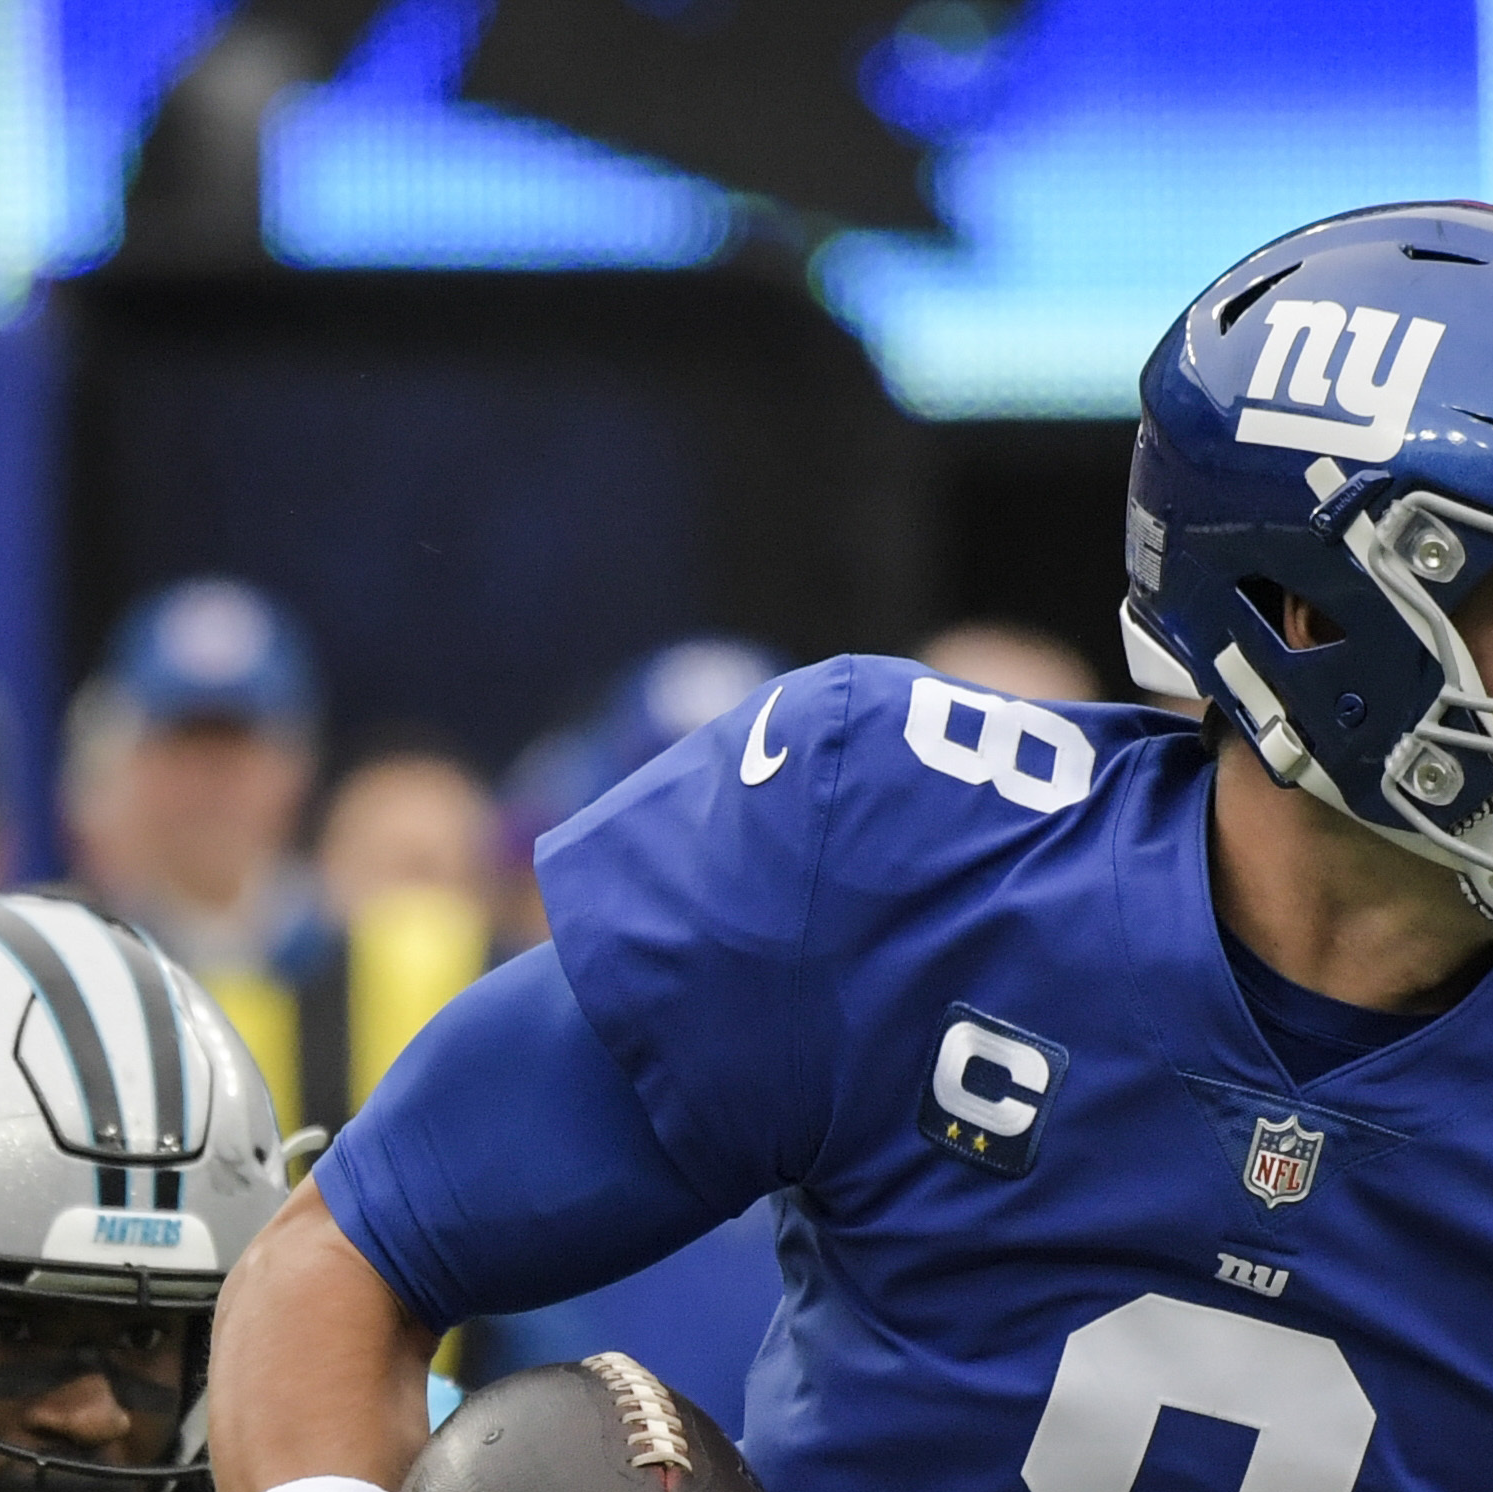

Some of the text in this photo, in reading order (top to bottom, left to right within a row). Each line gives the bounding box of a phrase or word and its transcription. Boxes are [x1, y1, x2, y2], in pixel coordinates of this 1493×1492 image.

[904, 677, 1096, 814] 8
[933, 1021, 1050, 1137] C
[1255, 1155, 1300, 1191] NFL
